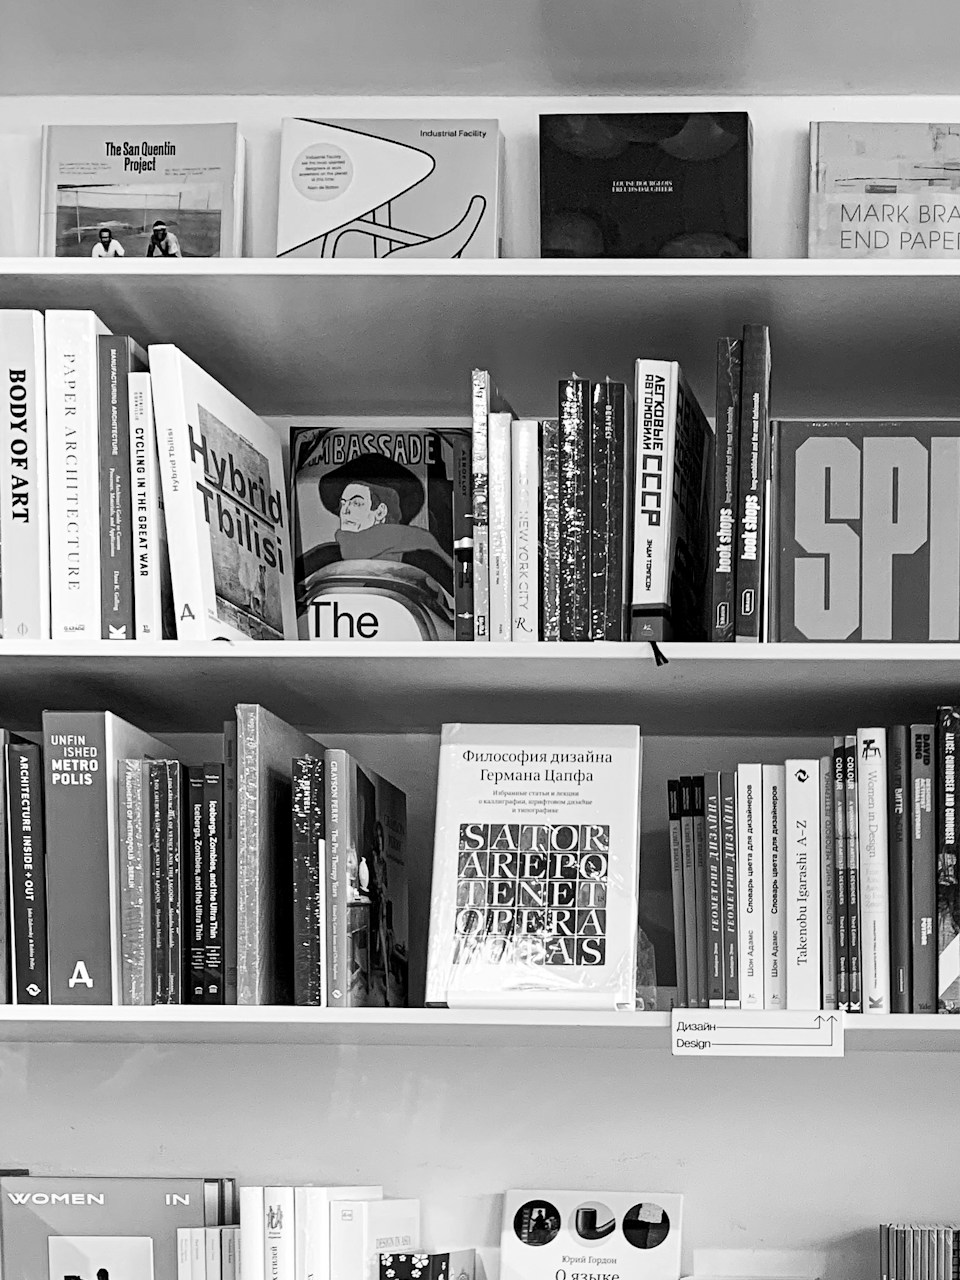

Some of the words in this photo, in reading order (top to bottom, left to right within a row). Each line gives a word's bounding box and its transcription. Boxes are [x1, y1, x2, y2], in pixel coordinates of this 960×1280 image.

[420, 129, 457, 138] Industrial
[458, 129, 487, 139] Facility
[105, 141, 122, 157] The
[122, 141, 140, 156] San
[141, 141, 176, 157] Quentin
[124, 155, 156, 175] Project
[840, 203, 909, 224] MARK
[840, 230, 890, 249] END
[63, 354, 77, 416] PAPER
[9, 368, 28, 433] BODY
[643, 374, 654, 450] АВТОМОБИЛИ
[653, 375, 665, 451] ЛЕГКОВЫЕ
[10, 438, 28, 470] OF
[135, 427, 146, 473] CYCLING
[137, 477, 146, 488] IN
[187, 425, 284, 528] Hybrid
[11, 474, 29, 523] ART
[137, 491, 147, 512] THE
[640, 454, 663, 527] СССР
[65, 430, 80, 590] ARCHITECTURE
[741, 494, 761, 531] shops
[138, 515, 148, 550] GREAT
[195, 482, 285, 575] Tbilisi
[740, 531, 758, 561] book
[139, 553, 149, 576] WAR
[310, 602, 378, 638] The
[51, 734, 87, 749] UNFIN
[63, 746, 98, 758] ISHED
[51, 758, 99, 772] METRO
[462, 750, 547, 767] Философия
[550, 750, 612, 764] дизайна
[52, 772, 93, 785] POLIS
[481, 769, 541, 785] Германа
[545, 769, 593, 786] Цапфа
[19, 755, 32, 832] ARCHITECTURE
[22, 835, 33, 870] INSIDE
[25, 871, 32, 879] +
[796, 852, 810, 902] Igarashi
[24, 879, 35, 901] OUT
[796, 906, 808, 966] Takenobu
[676, 1021, 717, 1032] Дизайн
[676, 1038, 712, 1050] Design
[7, 1192, 105, 1205] WOMEN
[165, 1194, 190, 1205] IN
[561, 1255, 587, 1265] Юрий
[588, 1255, 617, 1266] Гордон
